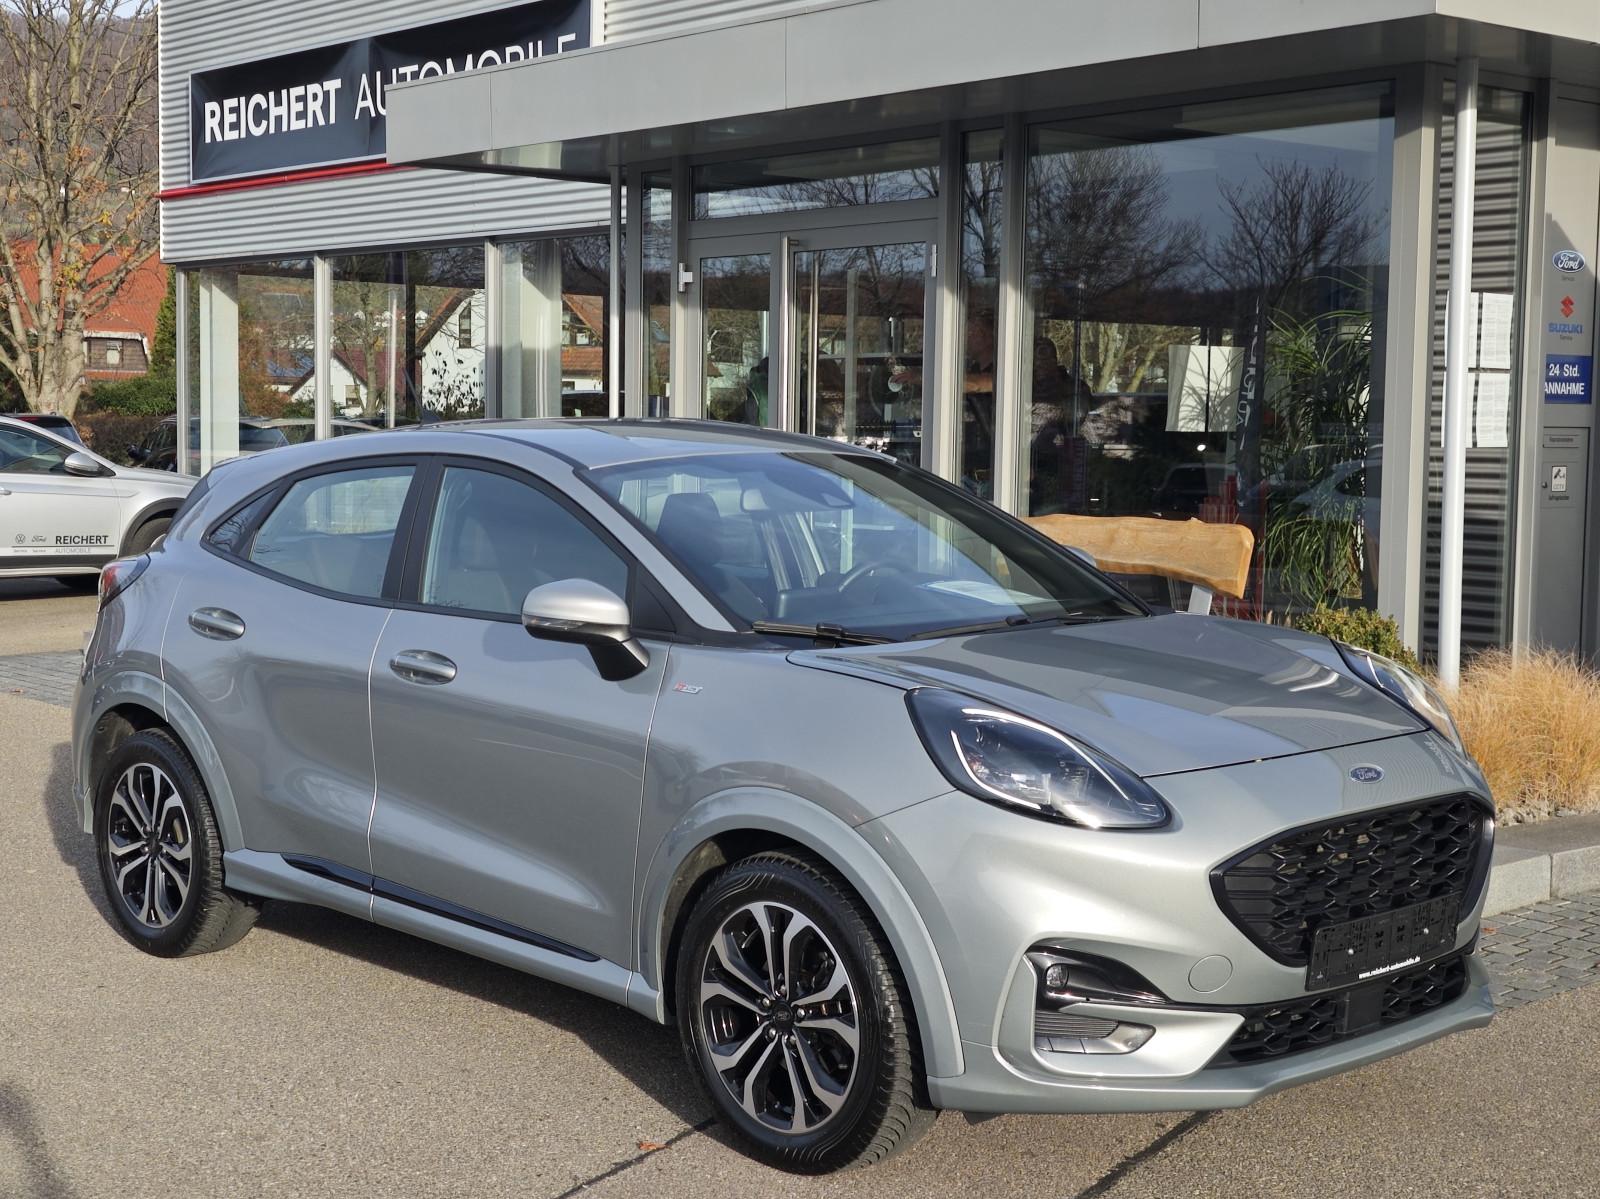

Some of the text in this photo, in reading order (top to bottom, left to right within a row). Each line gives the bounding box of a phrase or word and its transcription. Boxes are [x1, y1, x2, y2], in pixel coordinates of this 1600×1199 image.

[204, 78, 342, 144] REICHERT
[1548, 322, 1583, 334] SUZUKI
[1548, 363, 1580, 377] 24 Std.
[1544, 382, 1585, 395] ANNAHME
[55, 535, 109, 545] REICHERT
